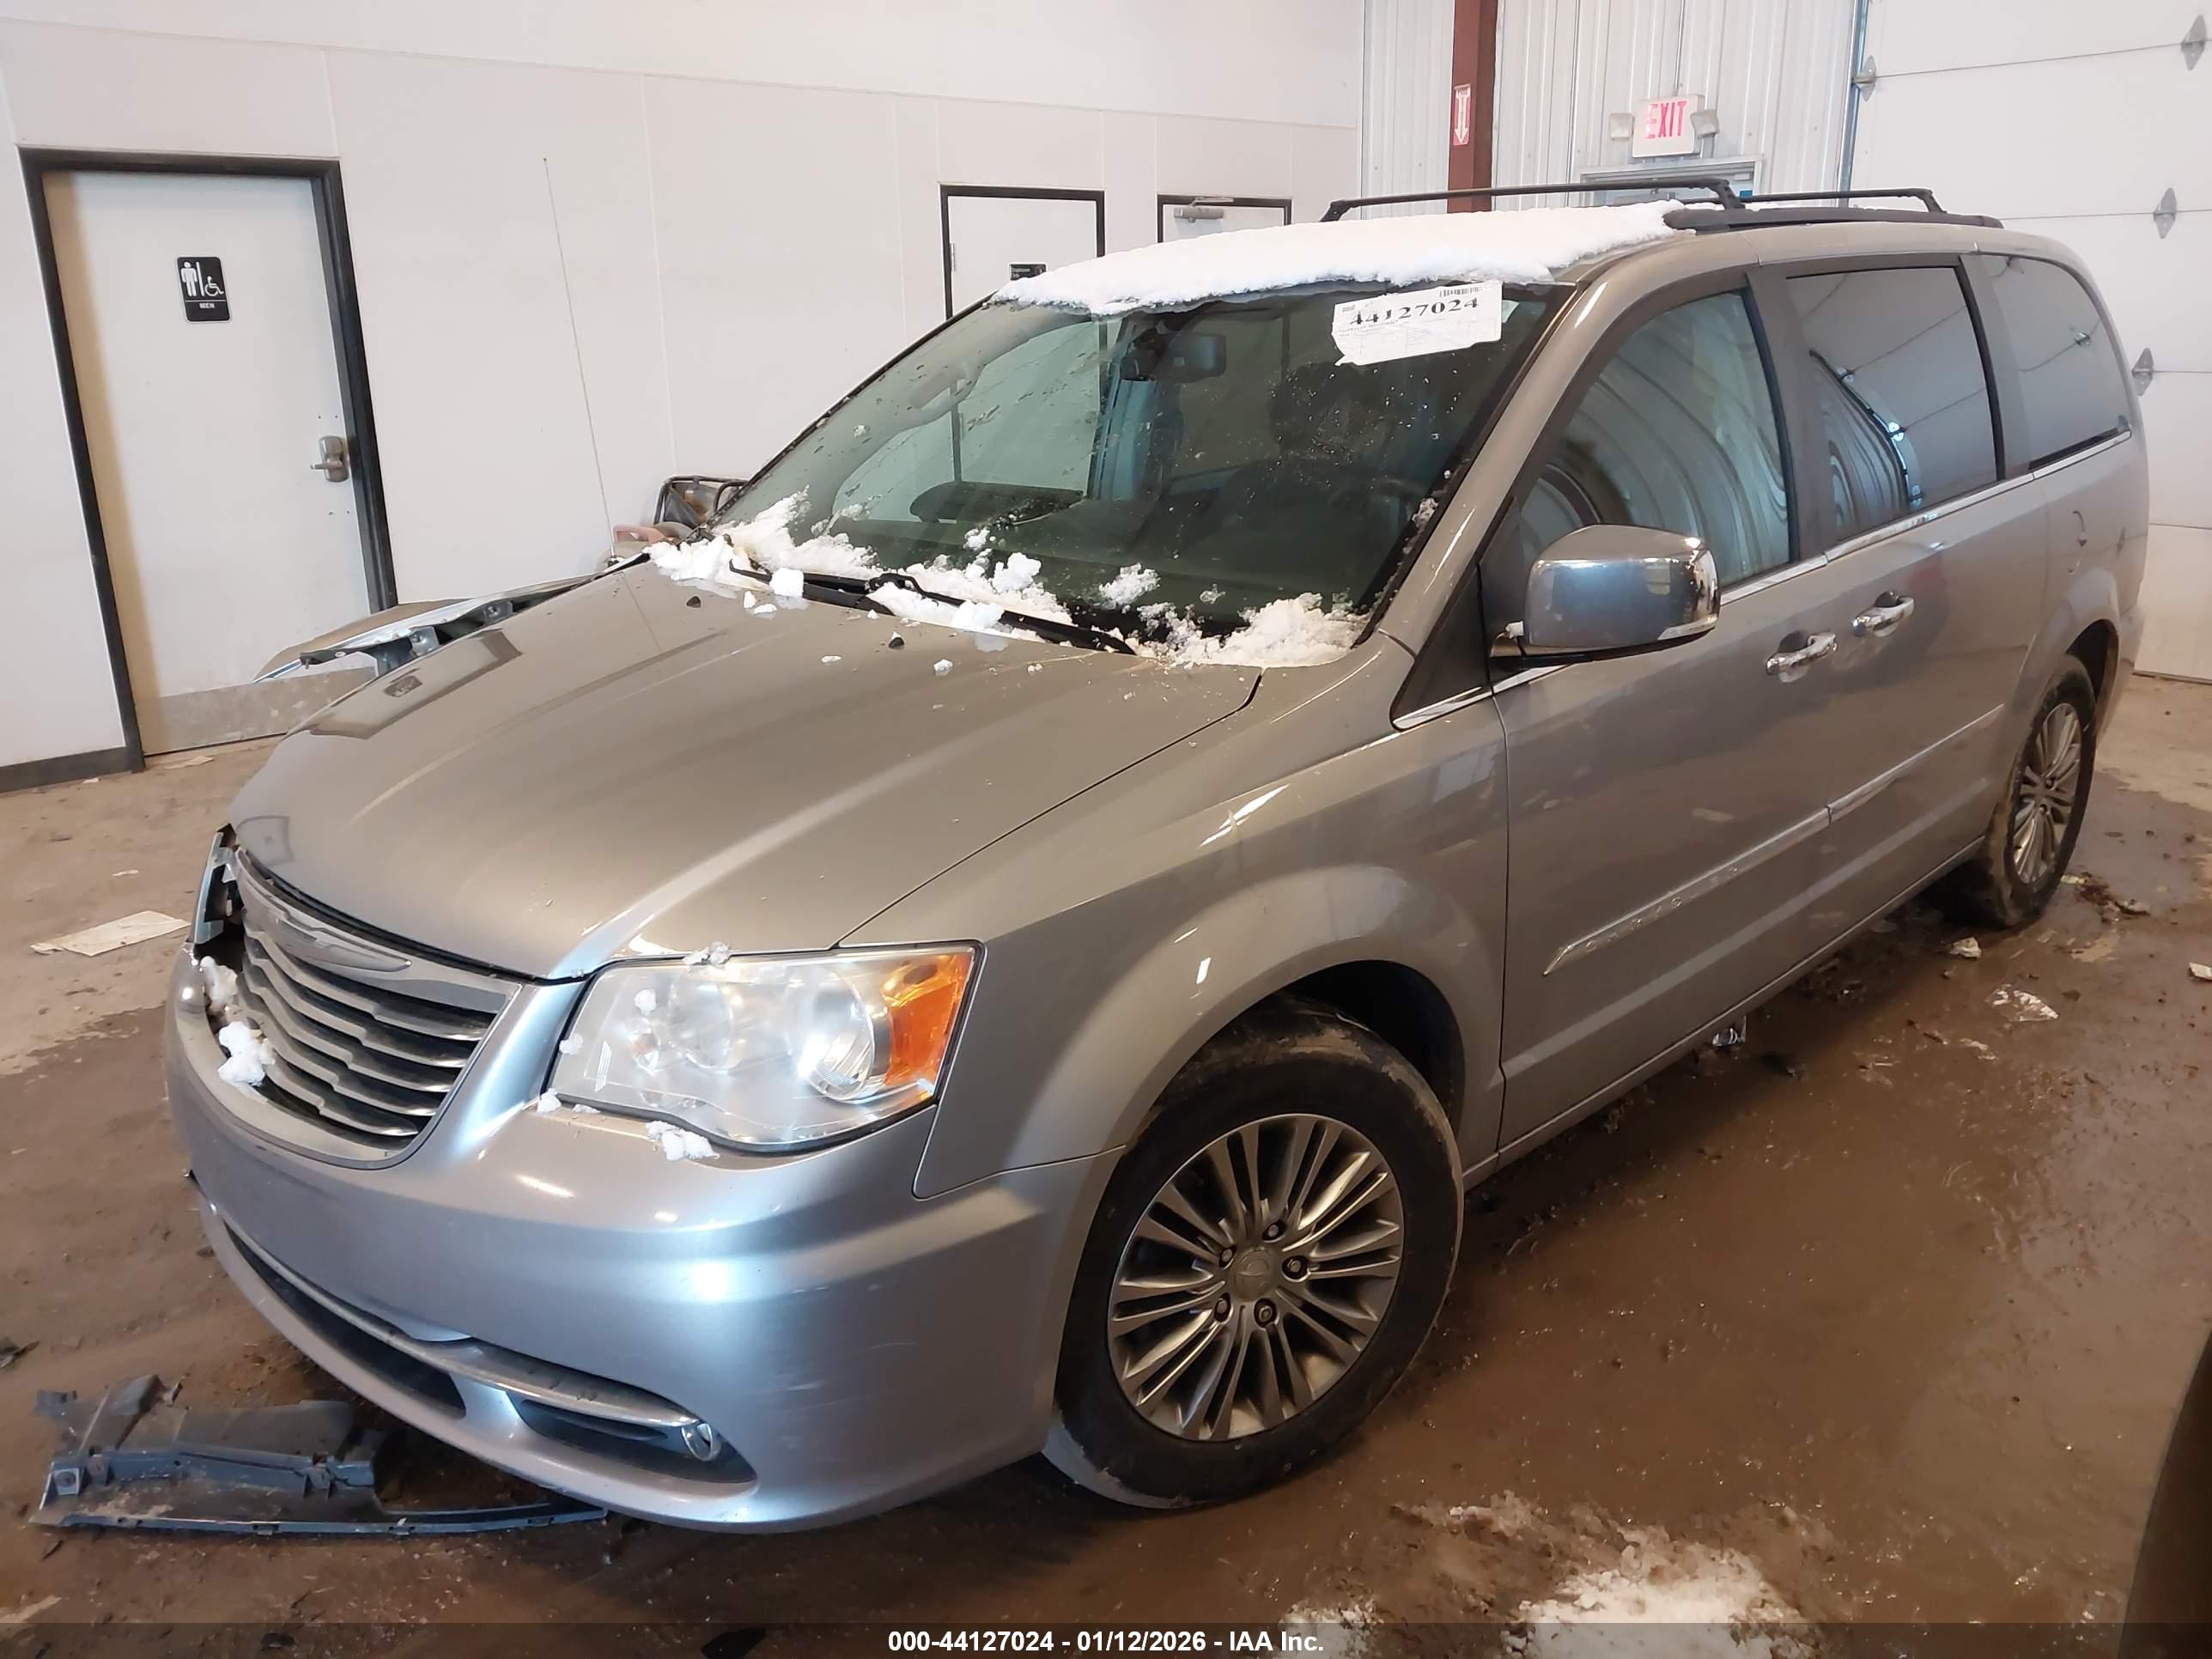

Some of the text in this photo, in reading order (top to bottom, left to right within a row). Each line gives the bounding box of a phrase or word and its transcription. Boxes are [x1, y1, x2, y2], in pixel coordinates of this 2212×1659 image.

[1646, 100, 1688, 139] EXIT
[1349, 296, 1478, 325] 44127024
[1586, 866, 1741, 951] CRYSER
